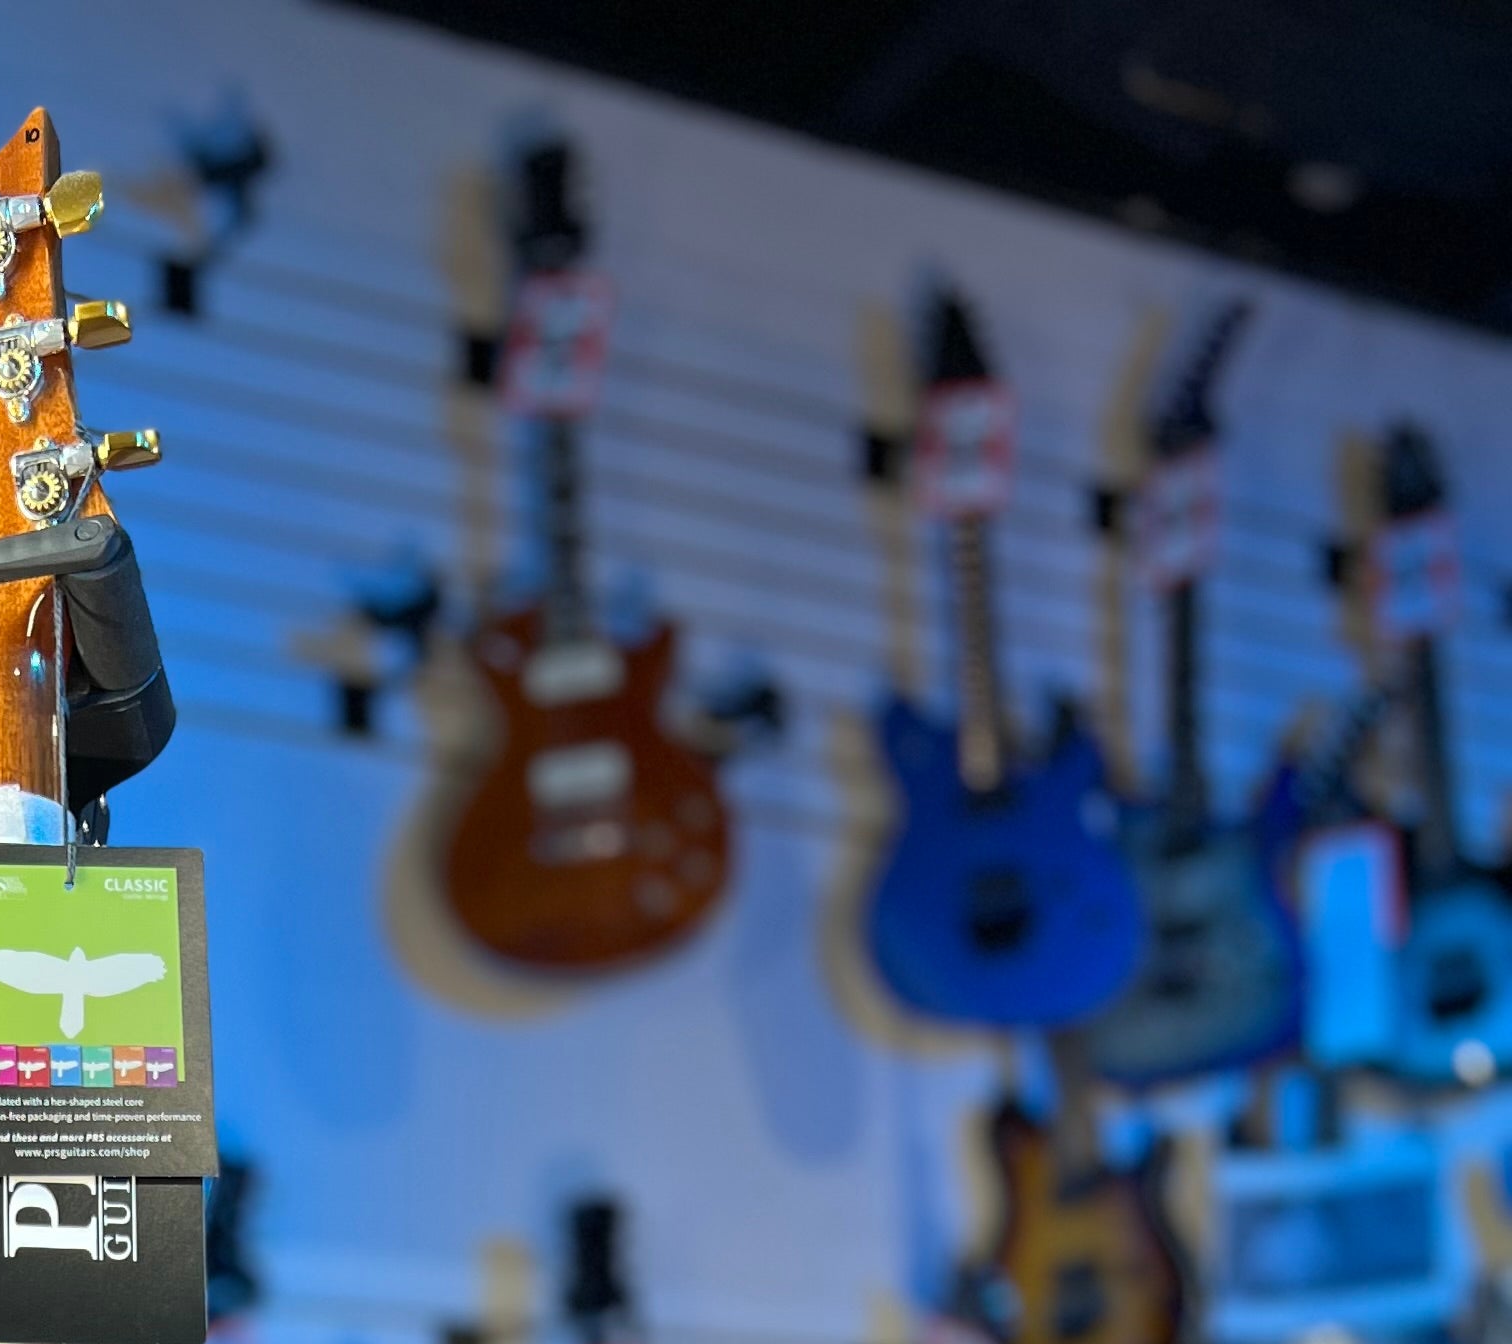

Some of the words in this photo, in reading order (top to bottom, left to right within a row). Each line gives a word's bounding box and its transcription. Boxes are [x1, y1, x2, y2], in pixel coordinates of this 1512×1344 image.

[104, 877, 169, 893] CLASSIC
[23, 1096, 43, 1107] with
[43, 1099, 50, 1107] a
[50, 1096, 101, 1109] hex-shaped
[102, 1097, 123, 1107] steel
[124, 1099, 144, 1107] core
[27, 1111, 73, 1124] packaging
[74, 1112, 91, 1122] and
[92, 1112, 146, 1124] time-proven
[146, 1111, 202, 1124] performance
[11, 1132, 39, 1143] these
[39, 1132, 59, 1143] and
[59, 1134, 85, 1143] more
[85, 1133, 105, 1143] PRS
[106, 1133, 160, 1143] accessories
[160, 1134, 173, 1143] at
[14, 1146, 151, 1160] www.prsguitars.com/shop
